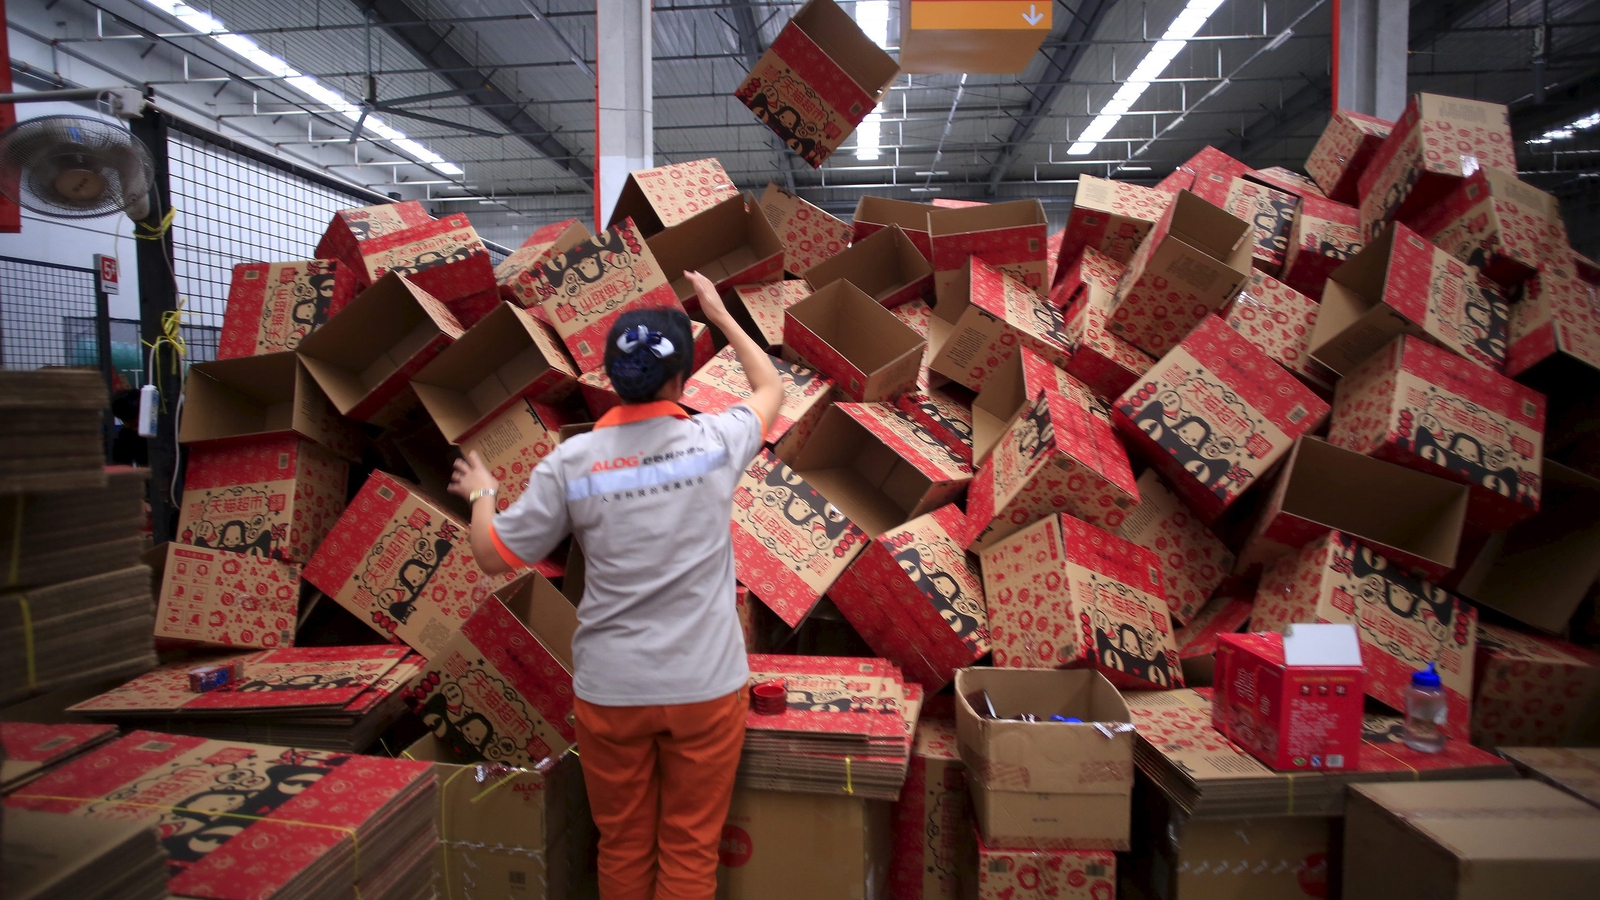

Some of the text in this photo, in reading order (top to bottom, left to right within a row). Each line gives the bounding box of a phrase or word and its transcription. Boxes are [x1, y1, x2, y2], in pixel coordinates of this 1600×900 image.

[780, 78, 825, 122] 天猫超市
[267, 287, 288, 338] 天猫超市
[577, 274, 632, 312] 天猫超市
[1185, 378, 1251, 437] 天猫超市
[1434, 397, 1503, 441] 天猫超市
[590, 455, 640, 473] ALOG
[209, 496, 262, 513] 天猫超市
[364, 527, 413, 586] 天猫超市
[750, 506, 808, 559] 天猫超市
[1357, 607, 1432, 660] 天猫超市
[467, 672, 530, 737] 天猫超市
